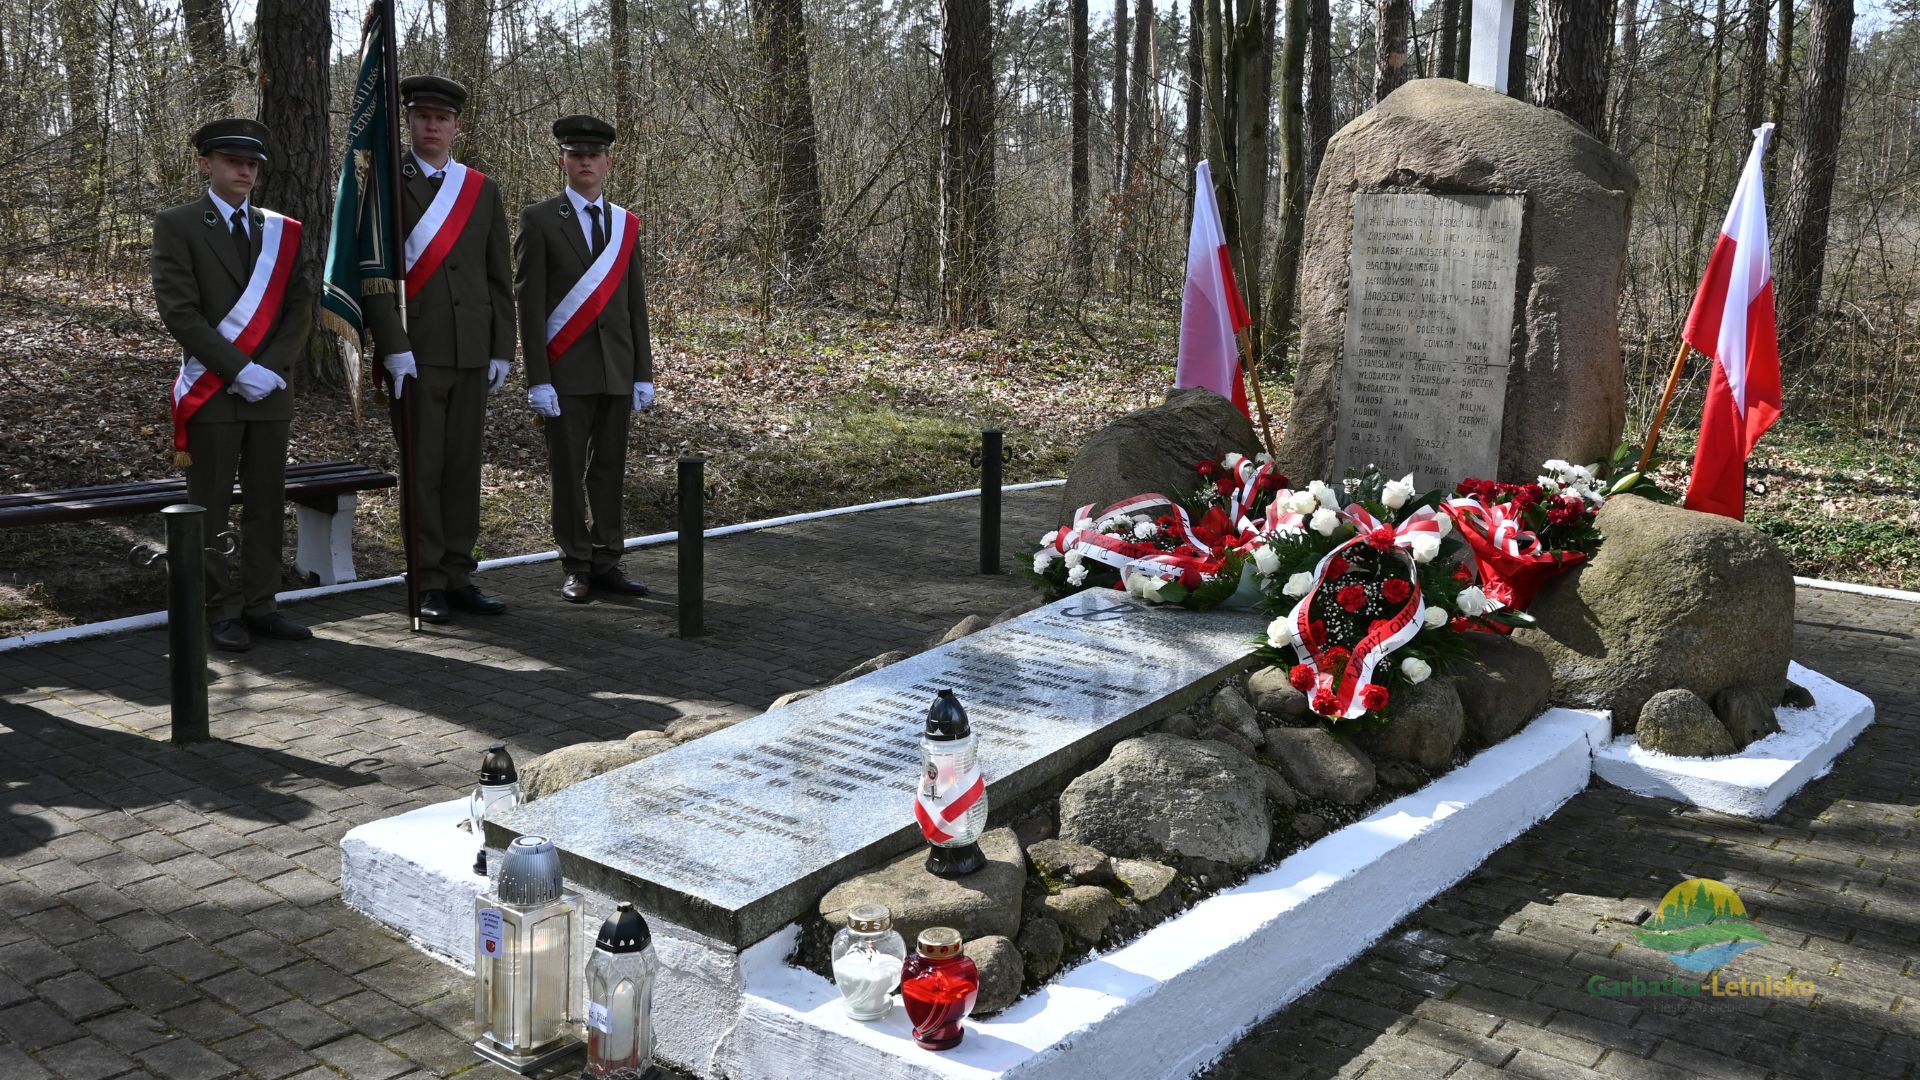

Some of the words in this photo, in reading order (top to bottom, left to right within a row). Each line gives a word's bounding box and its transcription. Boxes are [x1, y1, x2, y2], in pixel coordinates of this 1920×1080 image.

[1472, 280, 1497, 290] BURZA
[1394, 398, 1408, 406] JAN
[1459, 403, 1486, 413] MALINA
[1392, 410, 1420, 420] MARIAN
[1388, 422, 1403, 432] JAN
